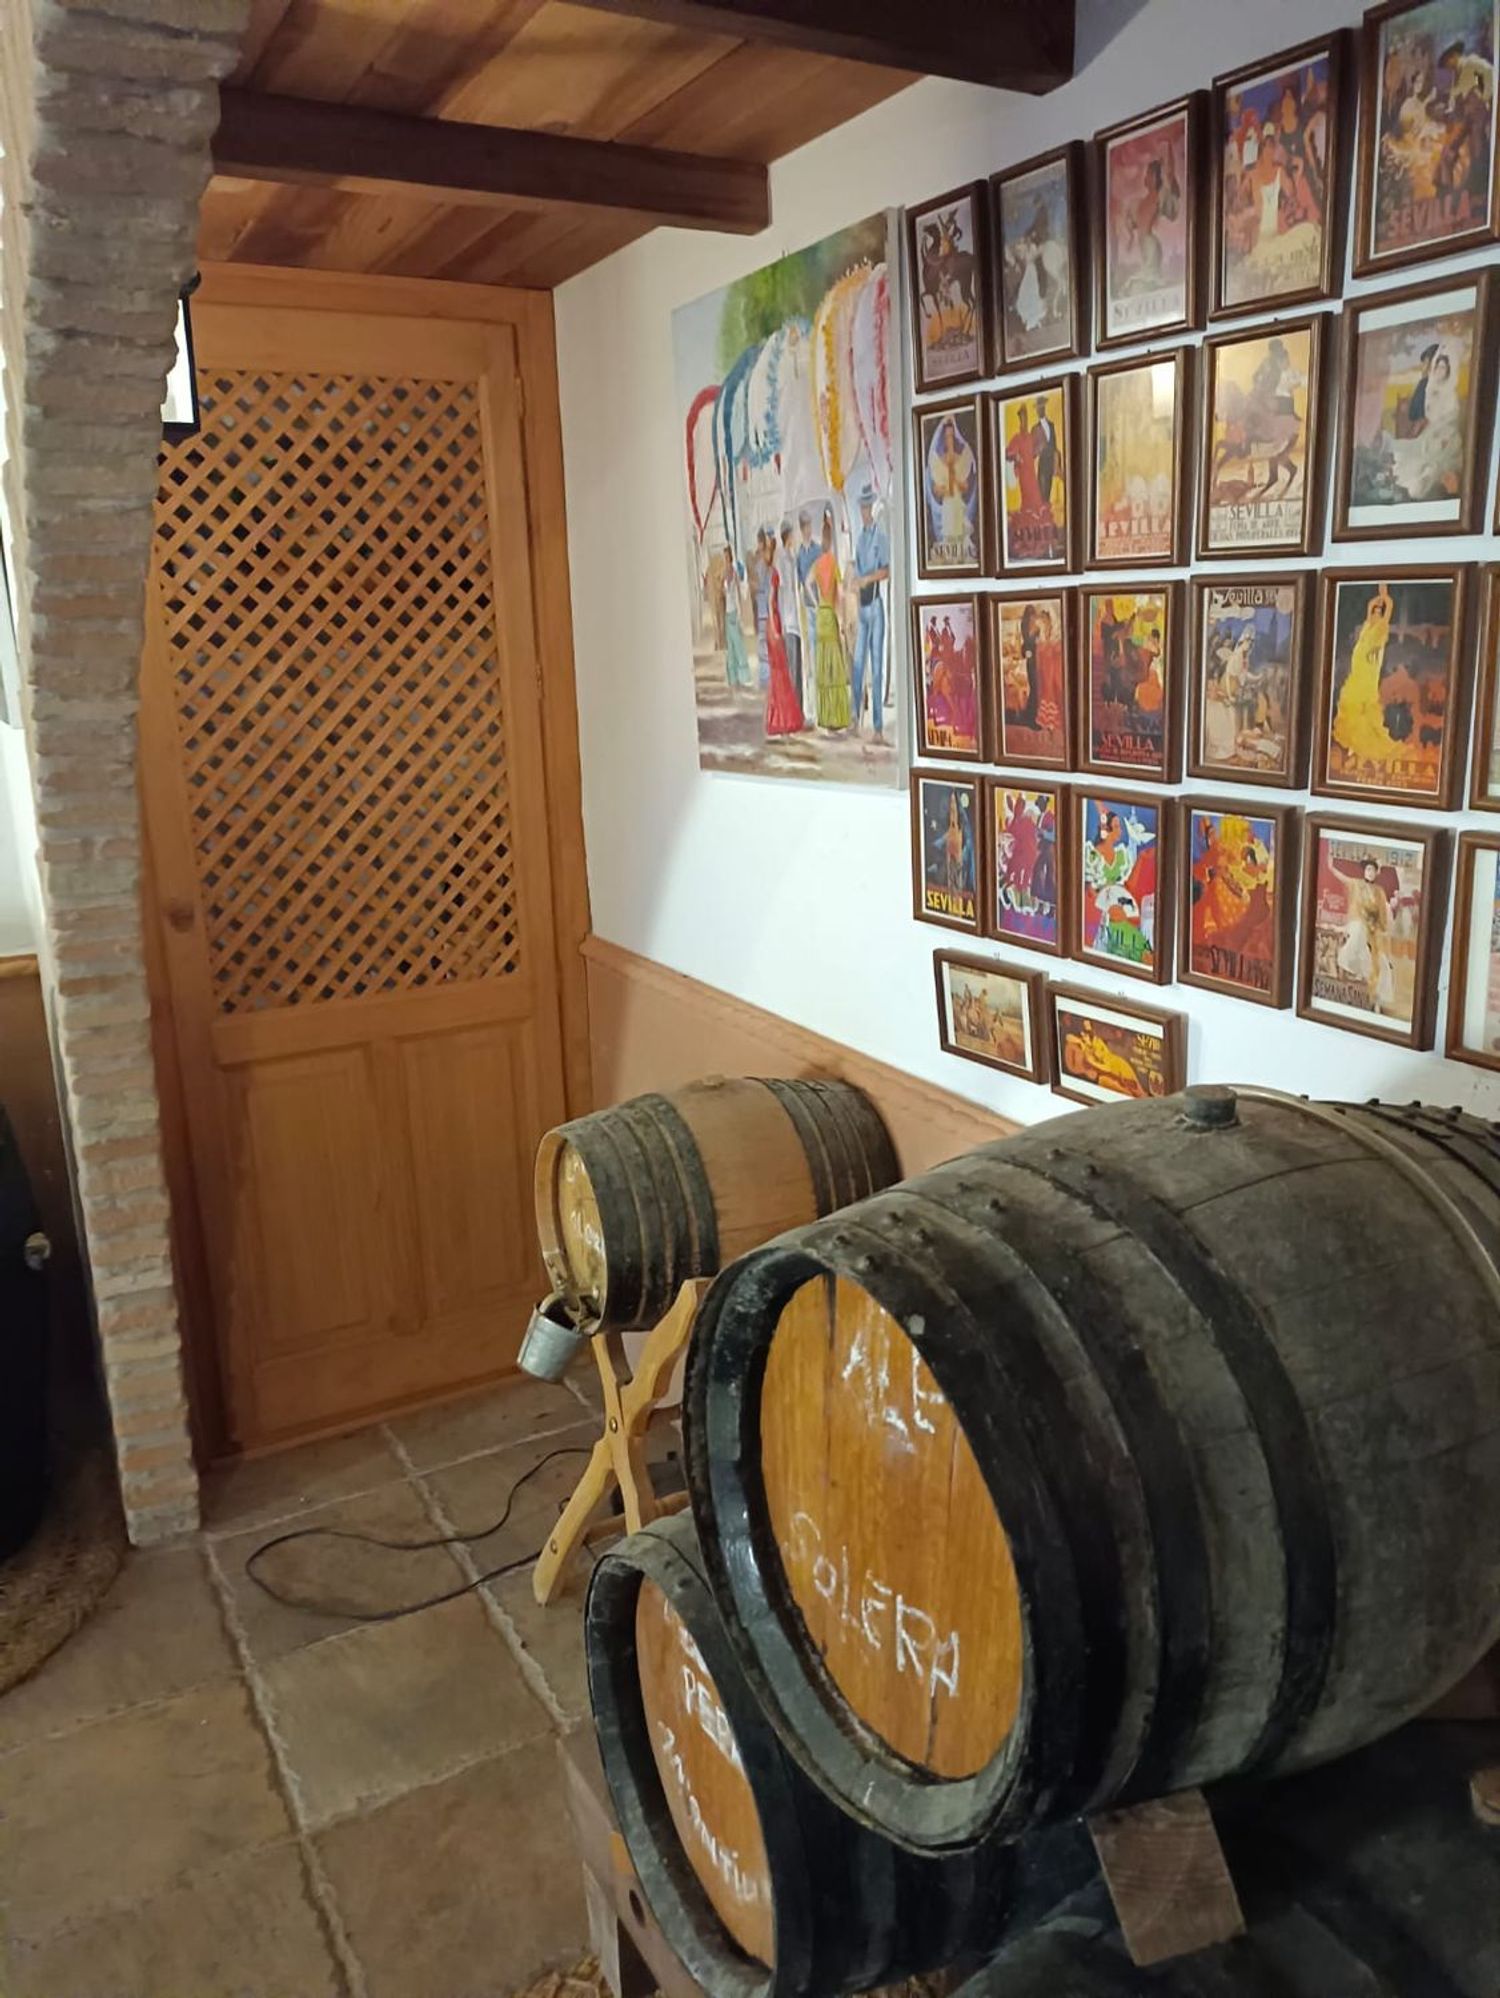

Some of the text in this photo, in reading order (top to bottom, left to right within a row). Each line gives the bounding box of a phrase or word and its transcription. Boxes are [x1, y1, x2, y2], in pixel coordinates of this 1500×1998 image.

[1229, 502, 1283, 520] SEVILLA
[1101, 734, 1154, 752] SEVILLA
[1344, 755, 1436, 779] SEVILLA
[927, 889, 974, 918] SEVILLA
[785, 1511, 960, 1698] SOLERA
